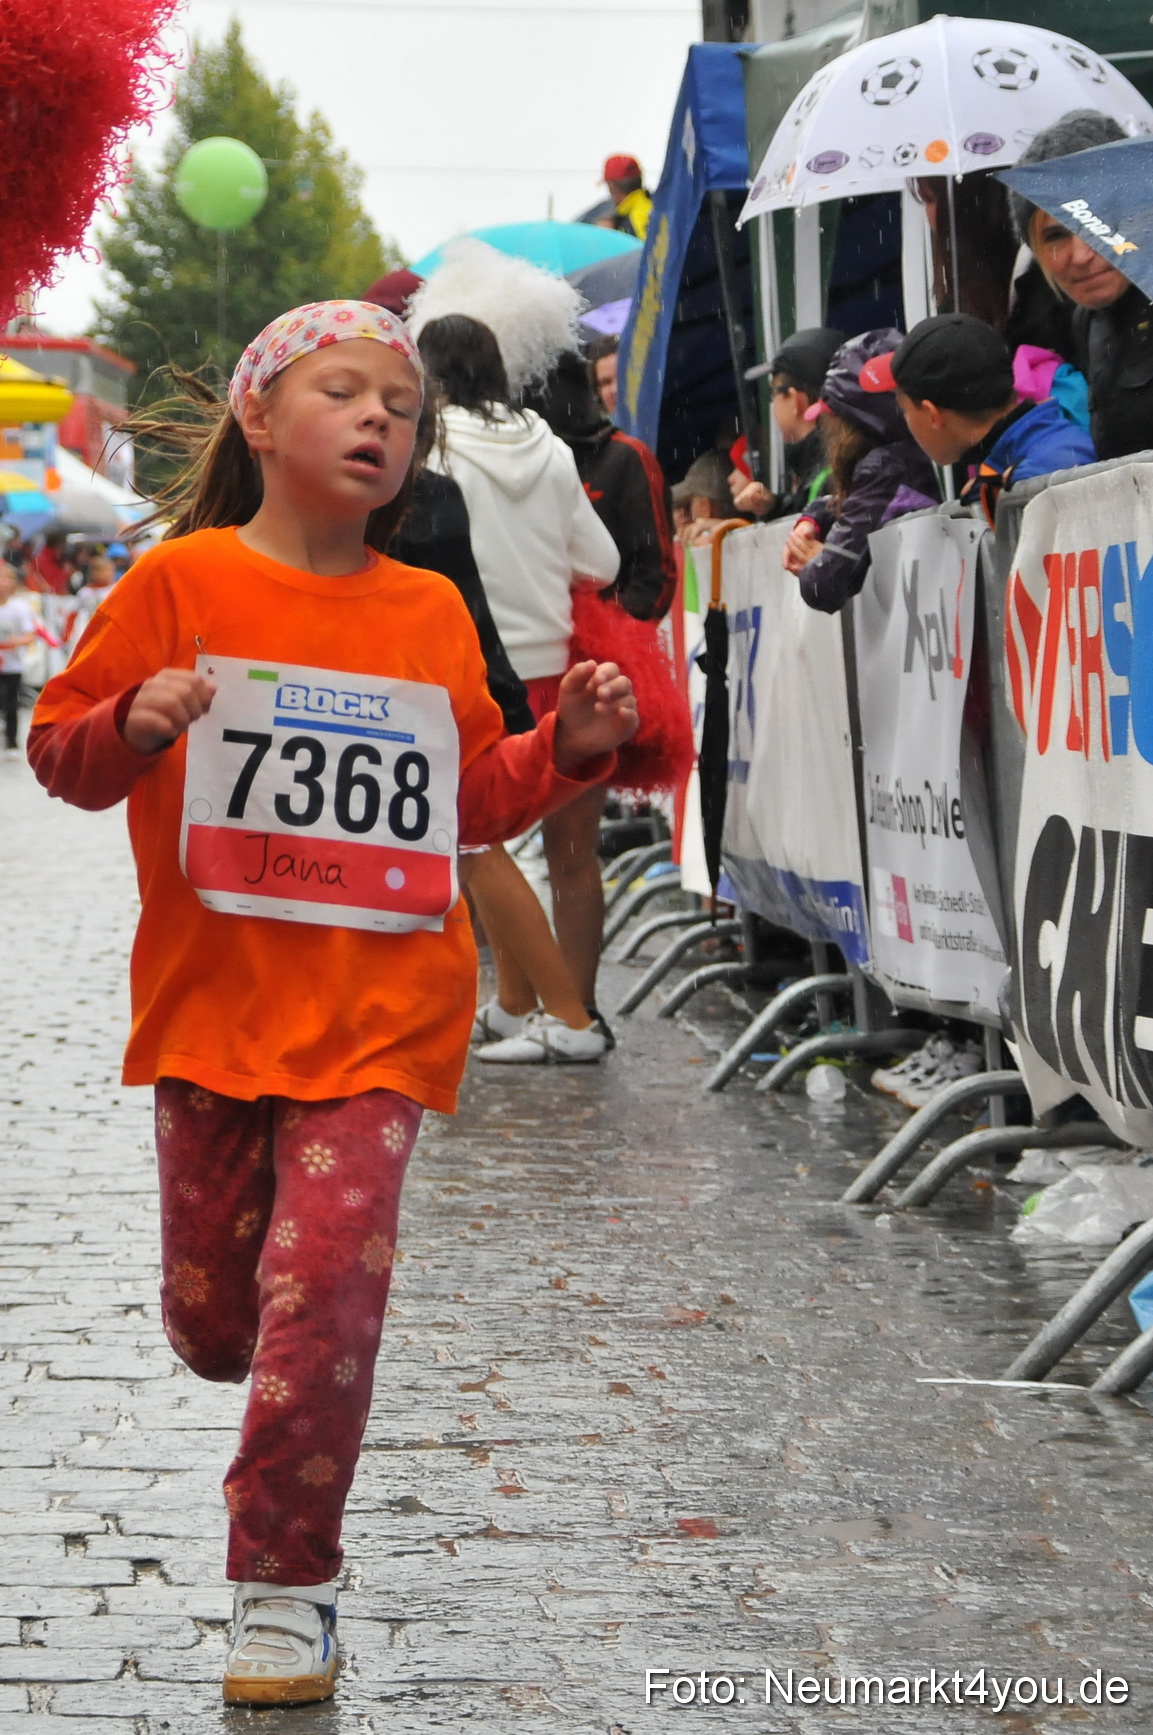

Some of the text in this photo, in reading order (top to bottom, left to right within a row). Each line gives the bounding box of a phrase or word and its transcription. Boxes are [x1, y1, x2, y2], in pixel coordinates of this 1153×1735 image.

[275, 684, 389, 721] BOCK
[222, 728, 430, 841] 7368
[244, 834, 348, 889] Jana
